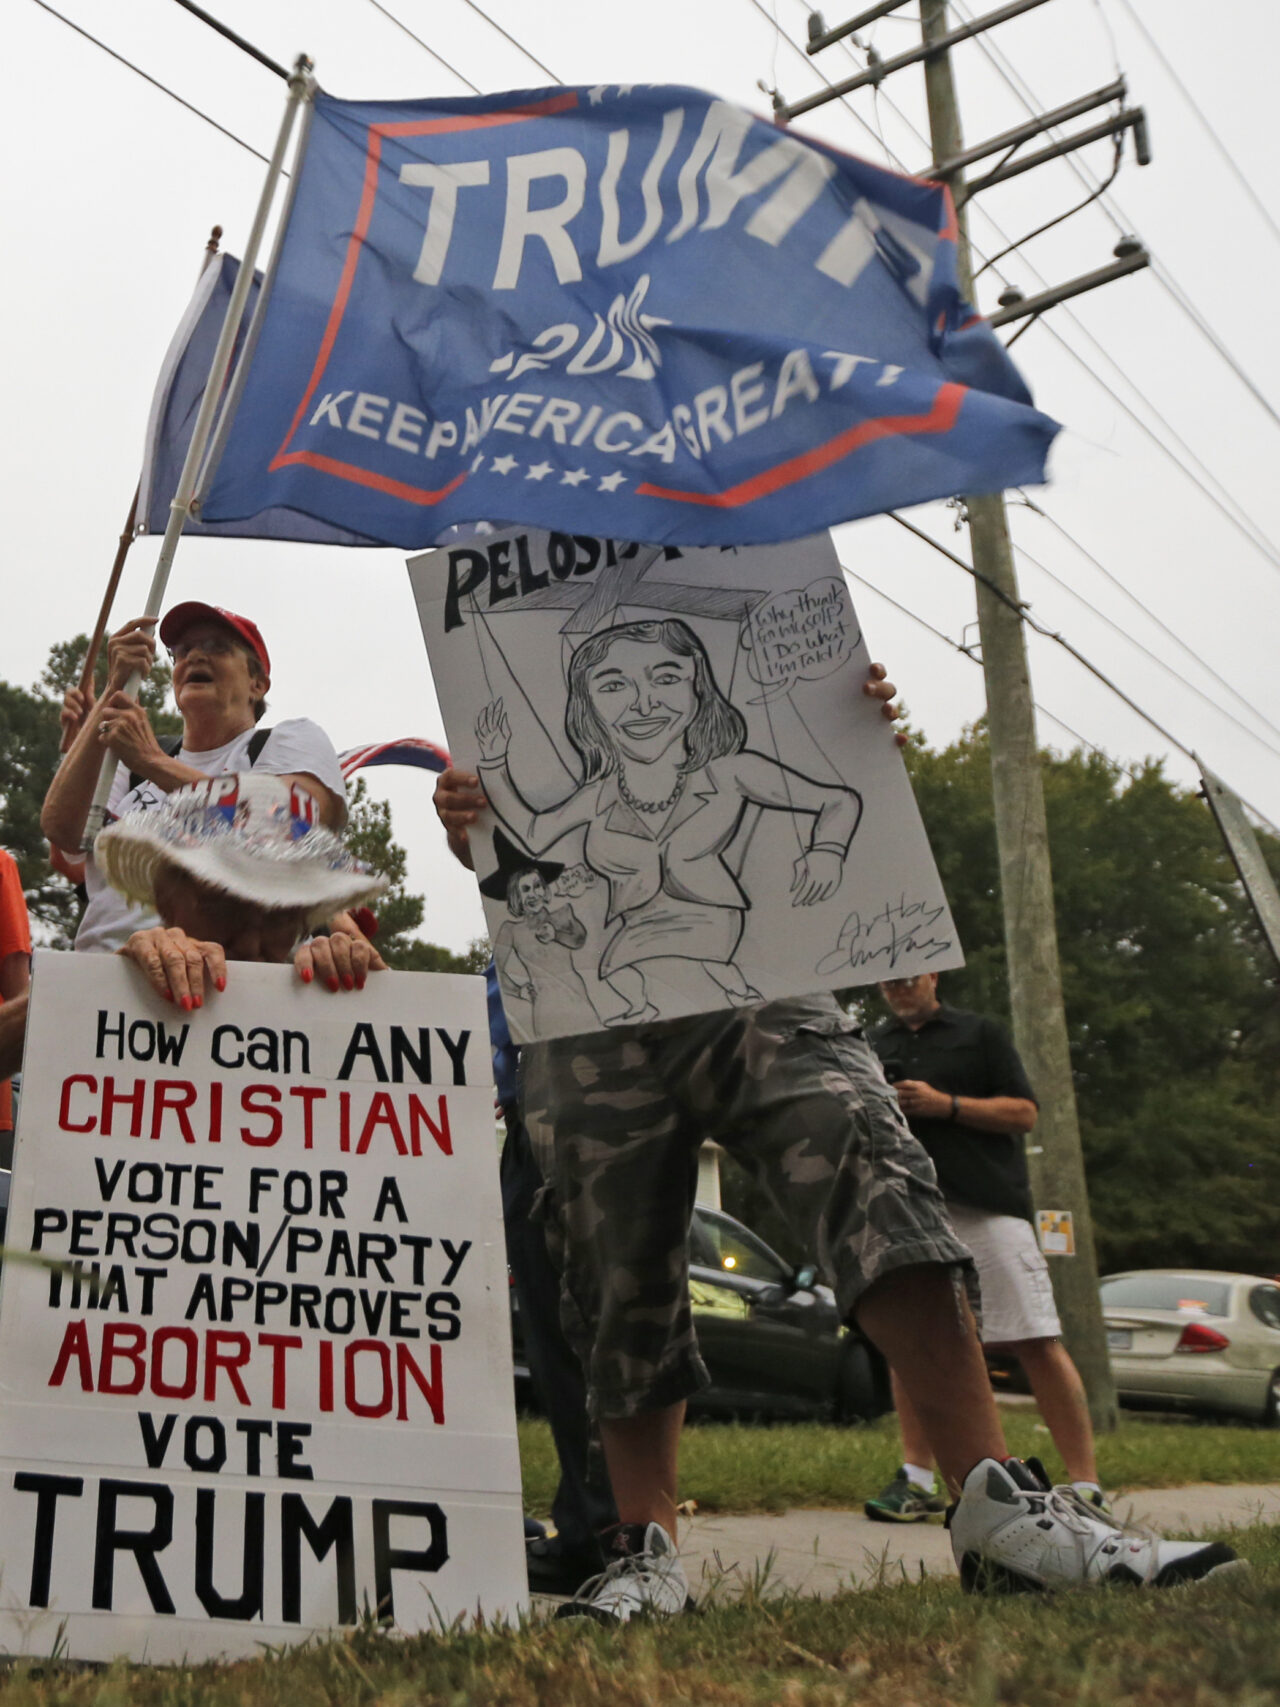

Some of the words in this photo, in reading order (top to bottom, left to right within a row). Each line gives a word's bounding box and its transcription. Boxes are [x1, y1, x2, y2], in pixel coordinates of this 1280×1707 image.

[309, 390, 458, 459] KEEP
[673, 348, 905, 460] GREAT!
[95, 1010, 189, 1066] How
[336, 1022, 472, 1086] ANY
[58, 1073, 454, 1157] CHRISTIAN
[94, 1157, 224, 1211] VOTE
[248, 1167, 348, 1220] FOR
[373, 1175, 409, 1223] A
[31, 1208, 472, 1287] PERSON/PARTY
[49, 1260, 168, 1316] THAT
[184, 1272, 462, 1341] APPROVES
[47, 1319, 445, 1425] ABORTION
[137, 1411, 314, 1481] VOTE
[13, 1471, 450, 1628] TRUMP
